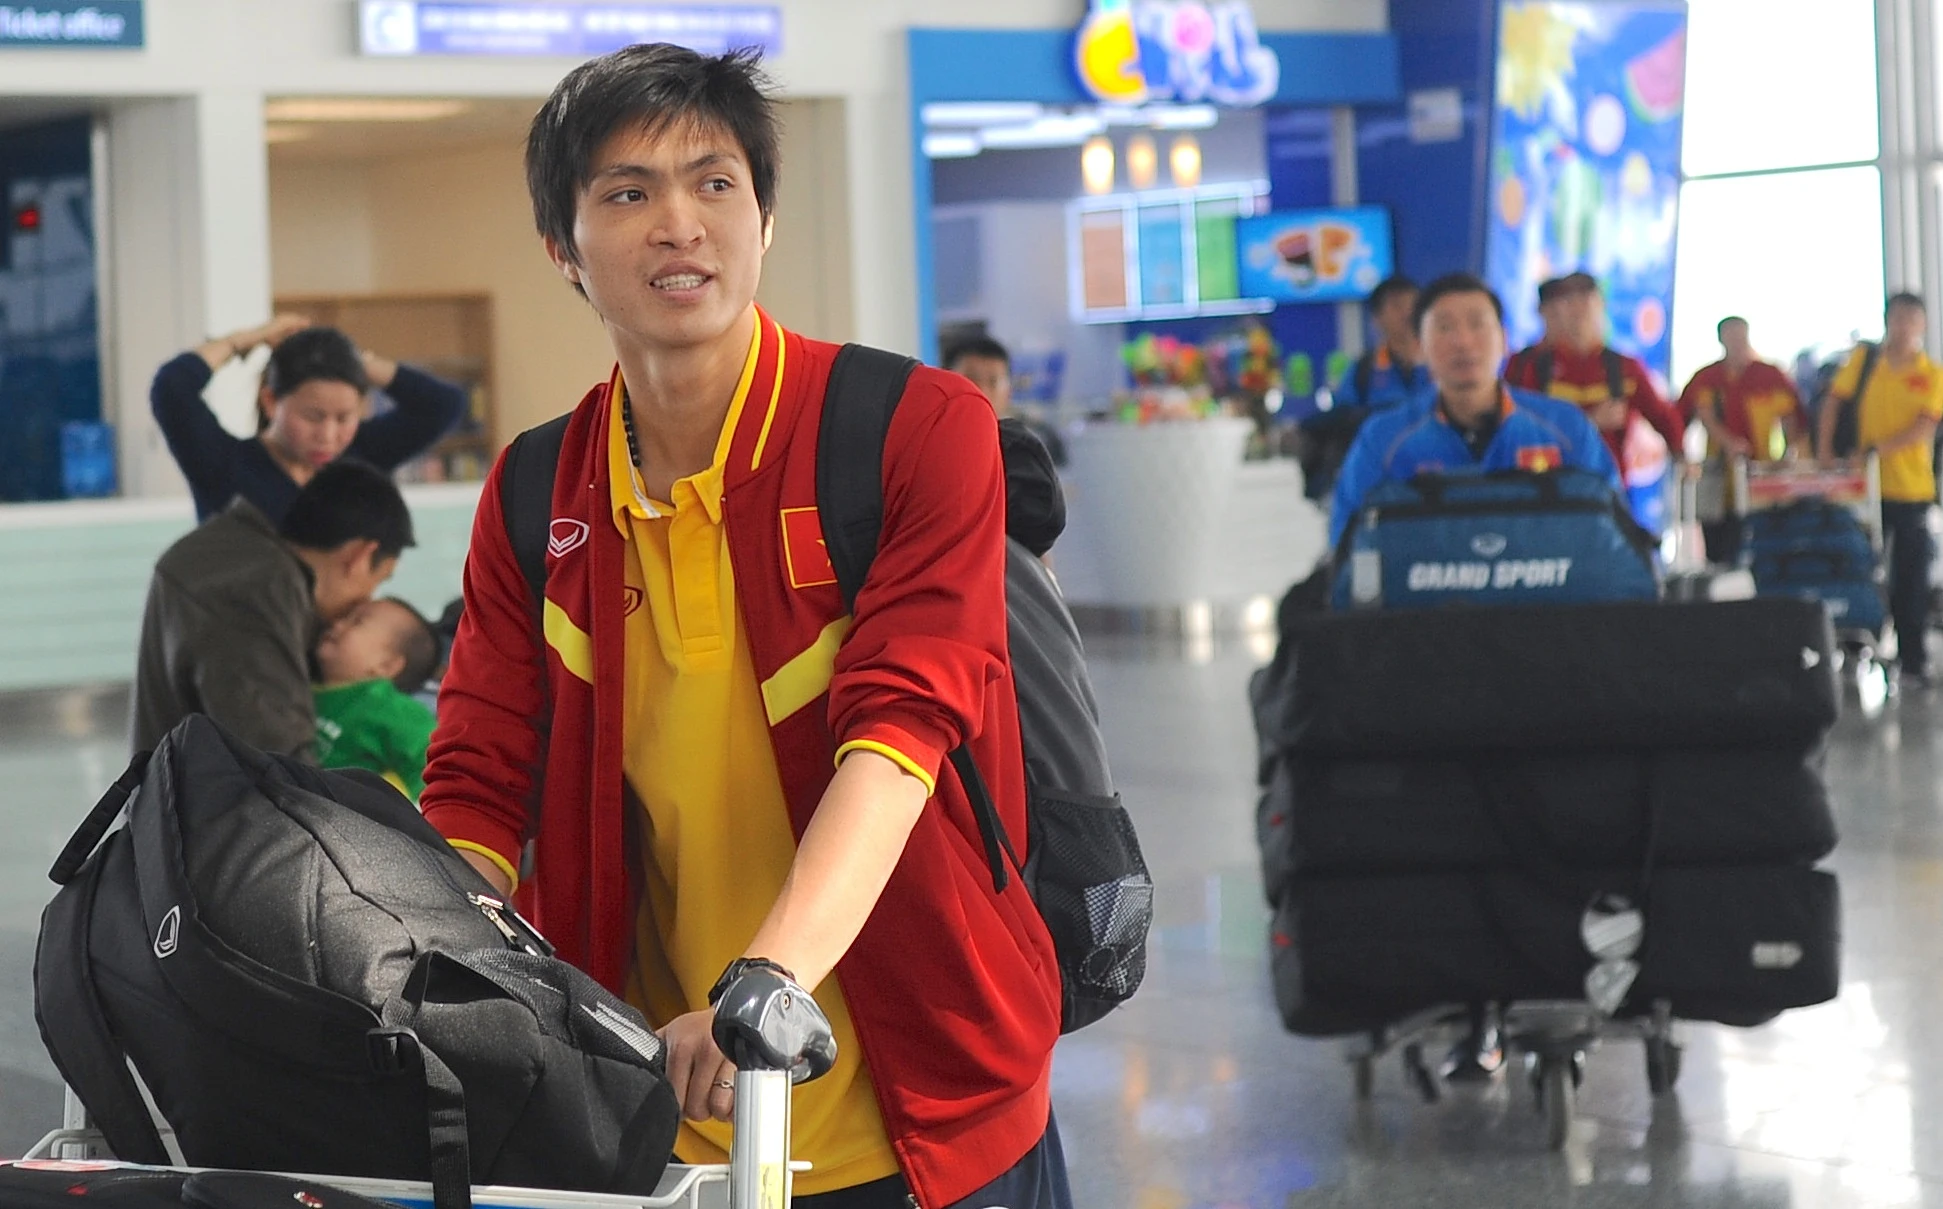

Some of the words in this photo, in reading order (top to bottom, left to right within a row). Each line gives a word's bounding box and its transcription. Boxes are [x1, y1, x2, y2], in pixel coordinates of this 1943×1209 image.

[61, 7, 125, 41] office
[1408, 562, 1490, 591] GRAND
[1492, 557, 1572, 589] SPORT
